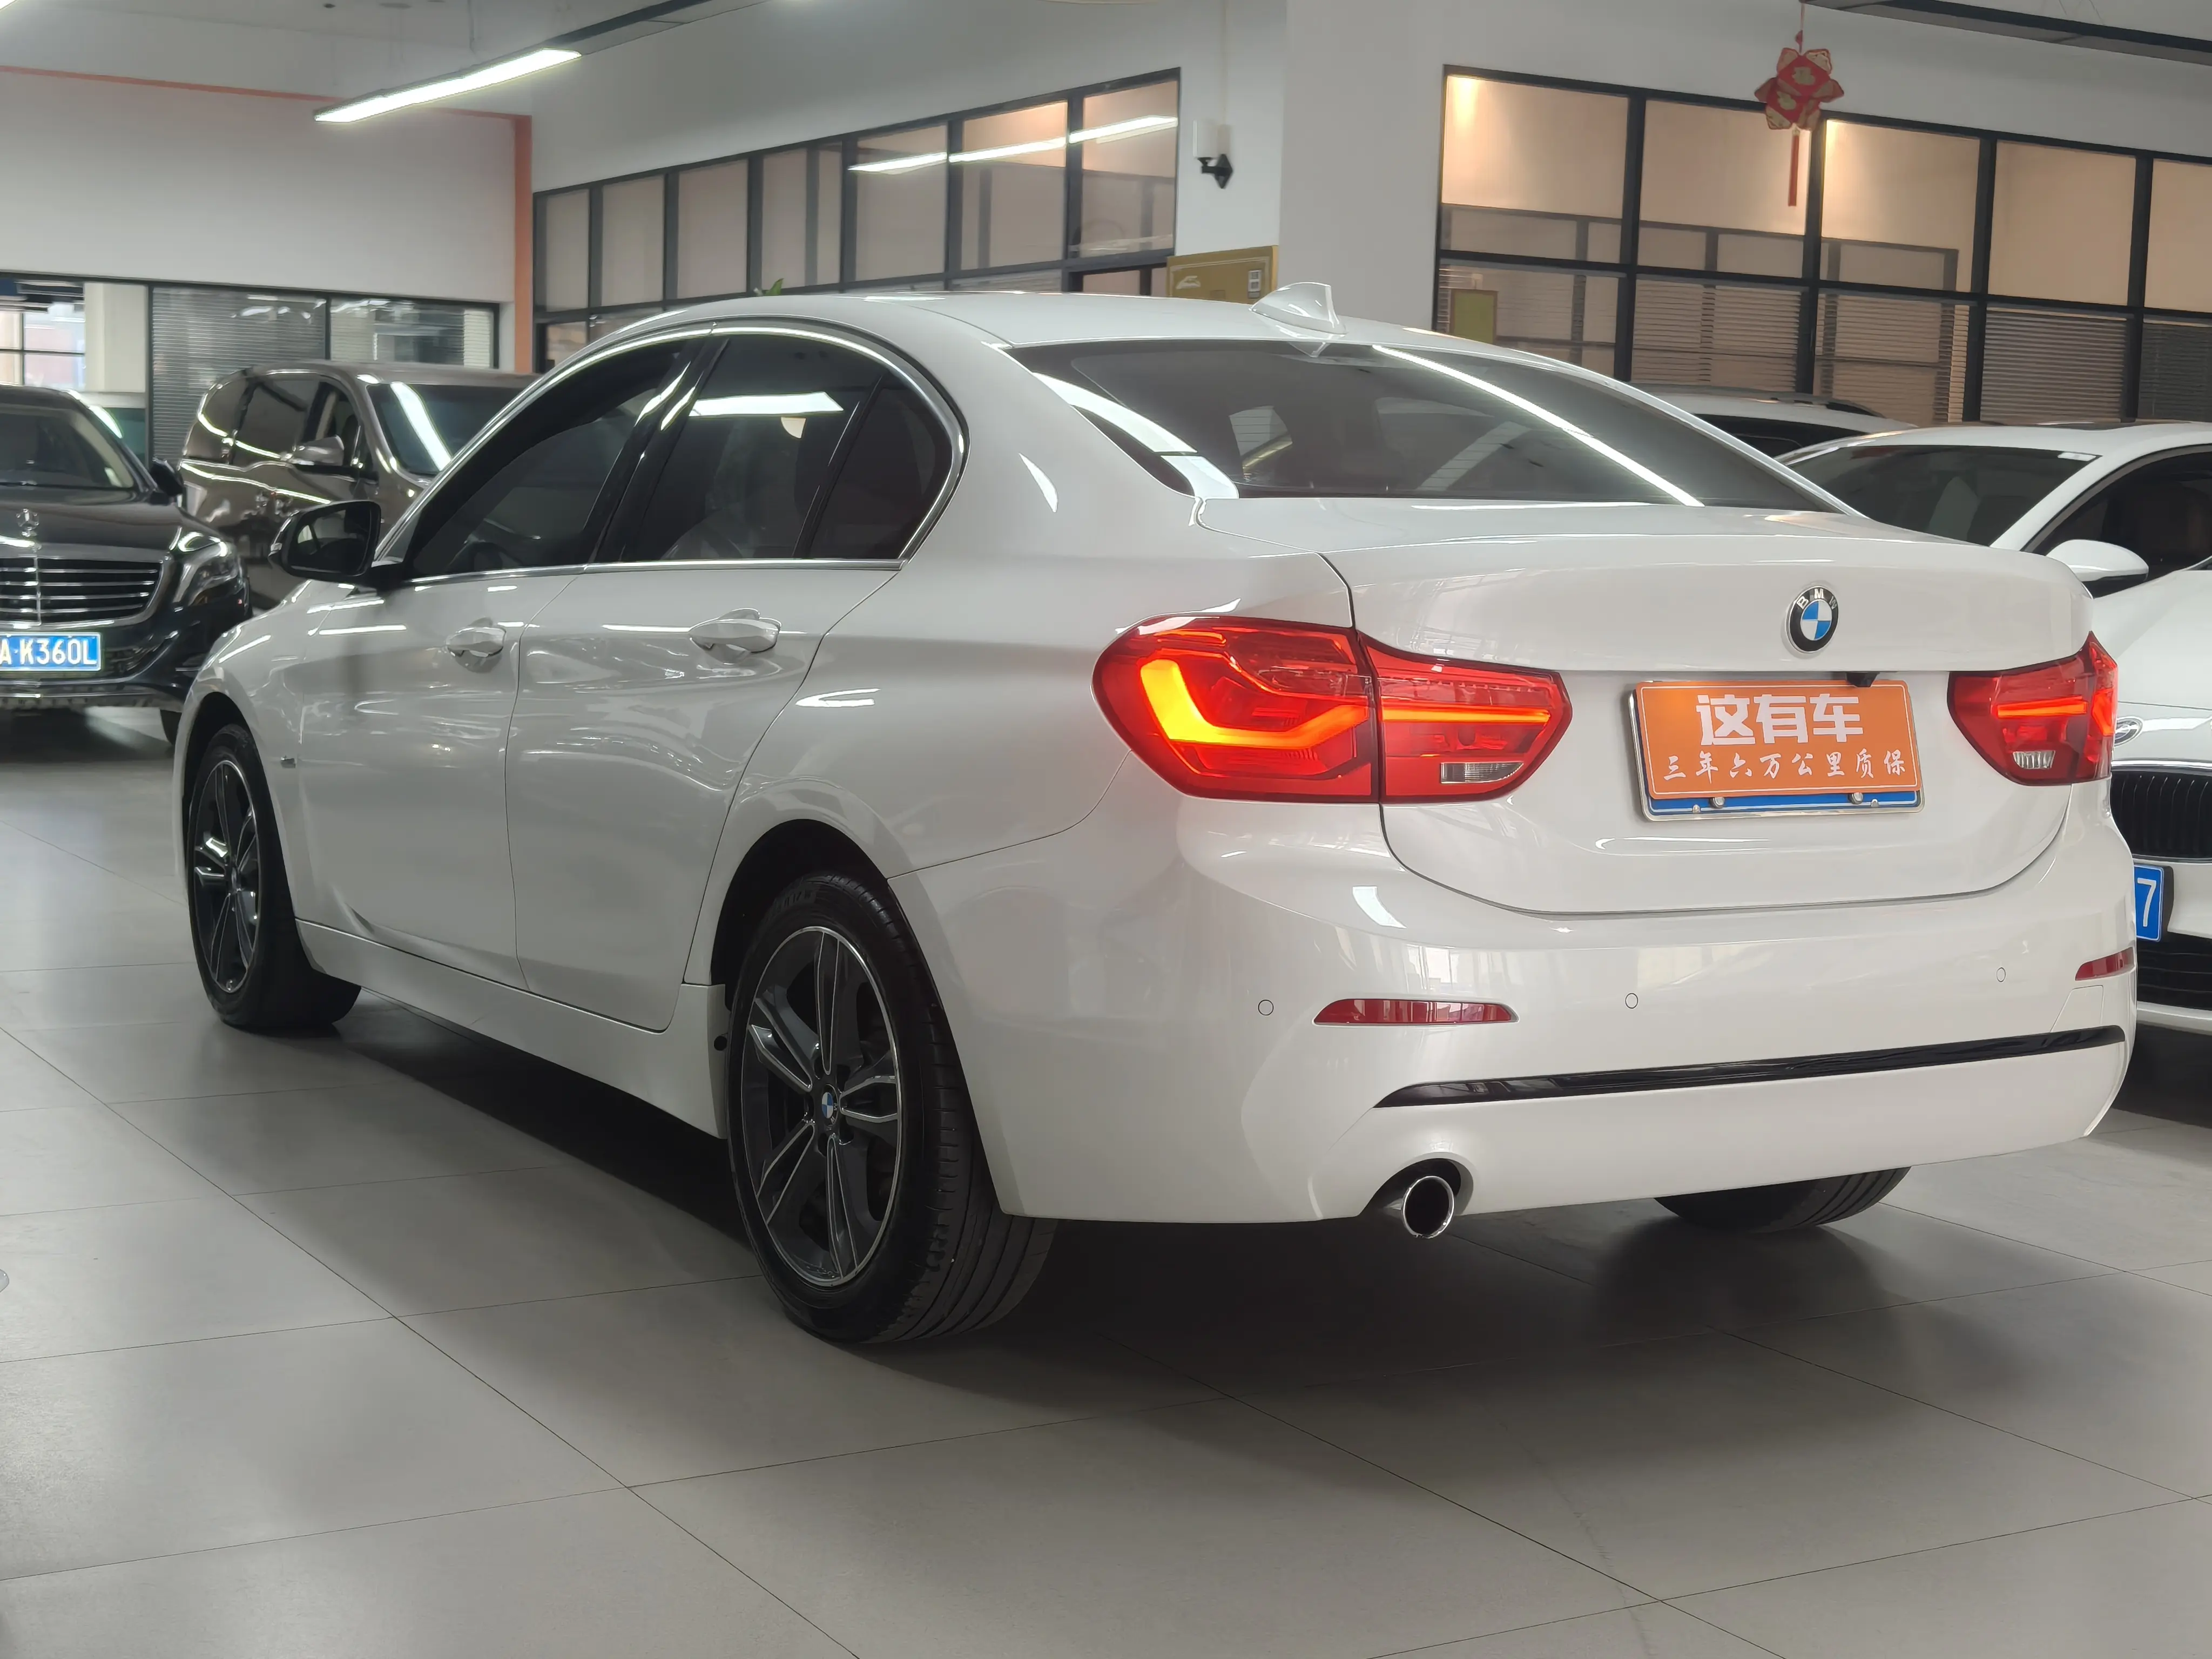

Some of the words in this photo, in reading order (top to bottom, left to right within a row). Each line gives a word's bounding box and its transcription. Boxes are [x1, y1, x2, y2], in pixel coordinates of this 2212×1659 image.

[1797, 588, 1837, 609] BMW
[1696, 694, 1863, 745] 这有车
[1663, 748, 1906, 784] 三年六万公里质保
